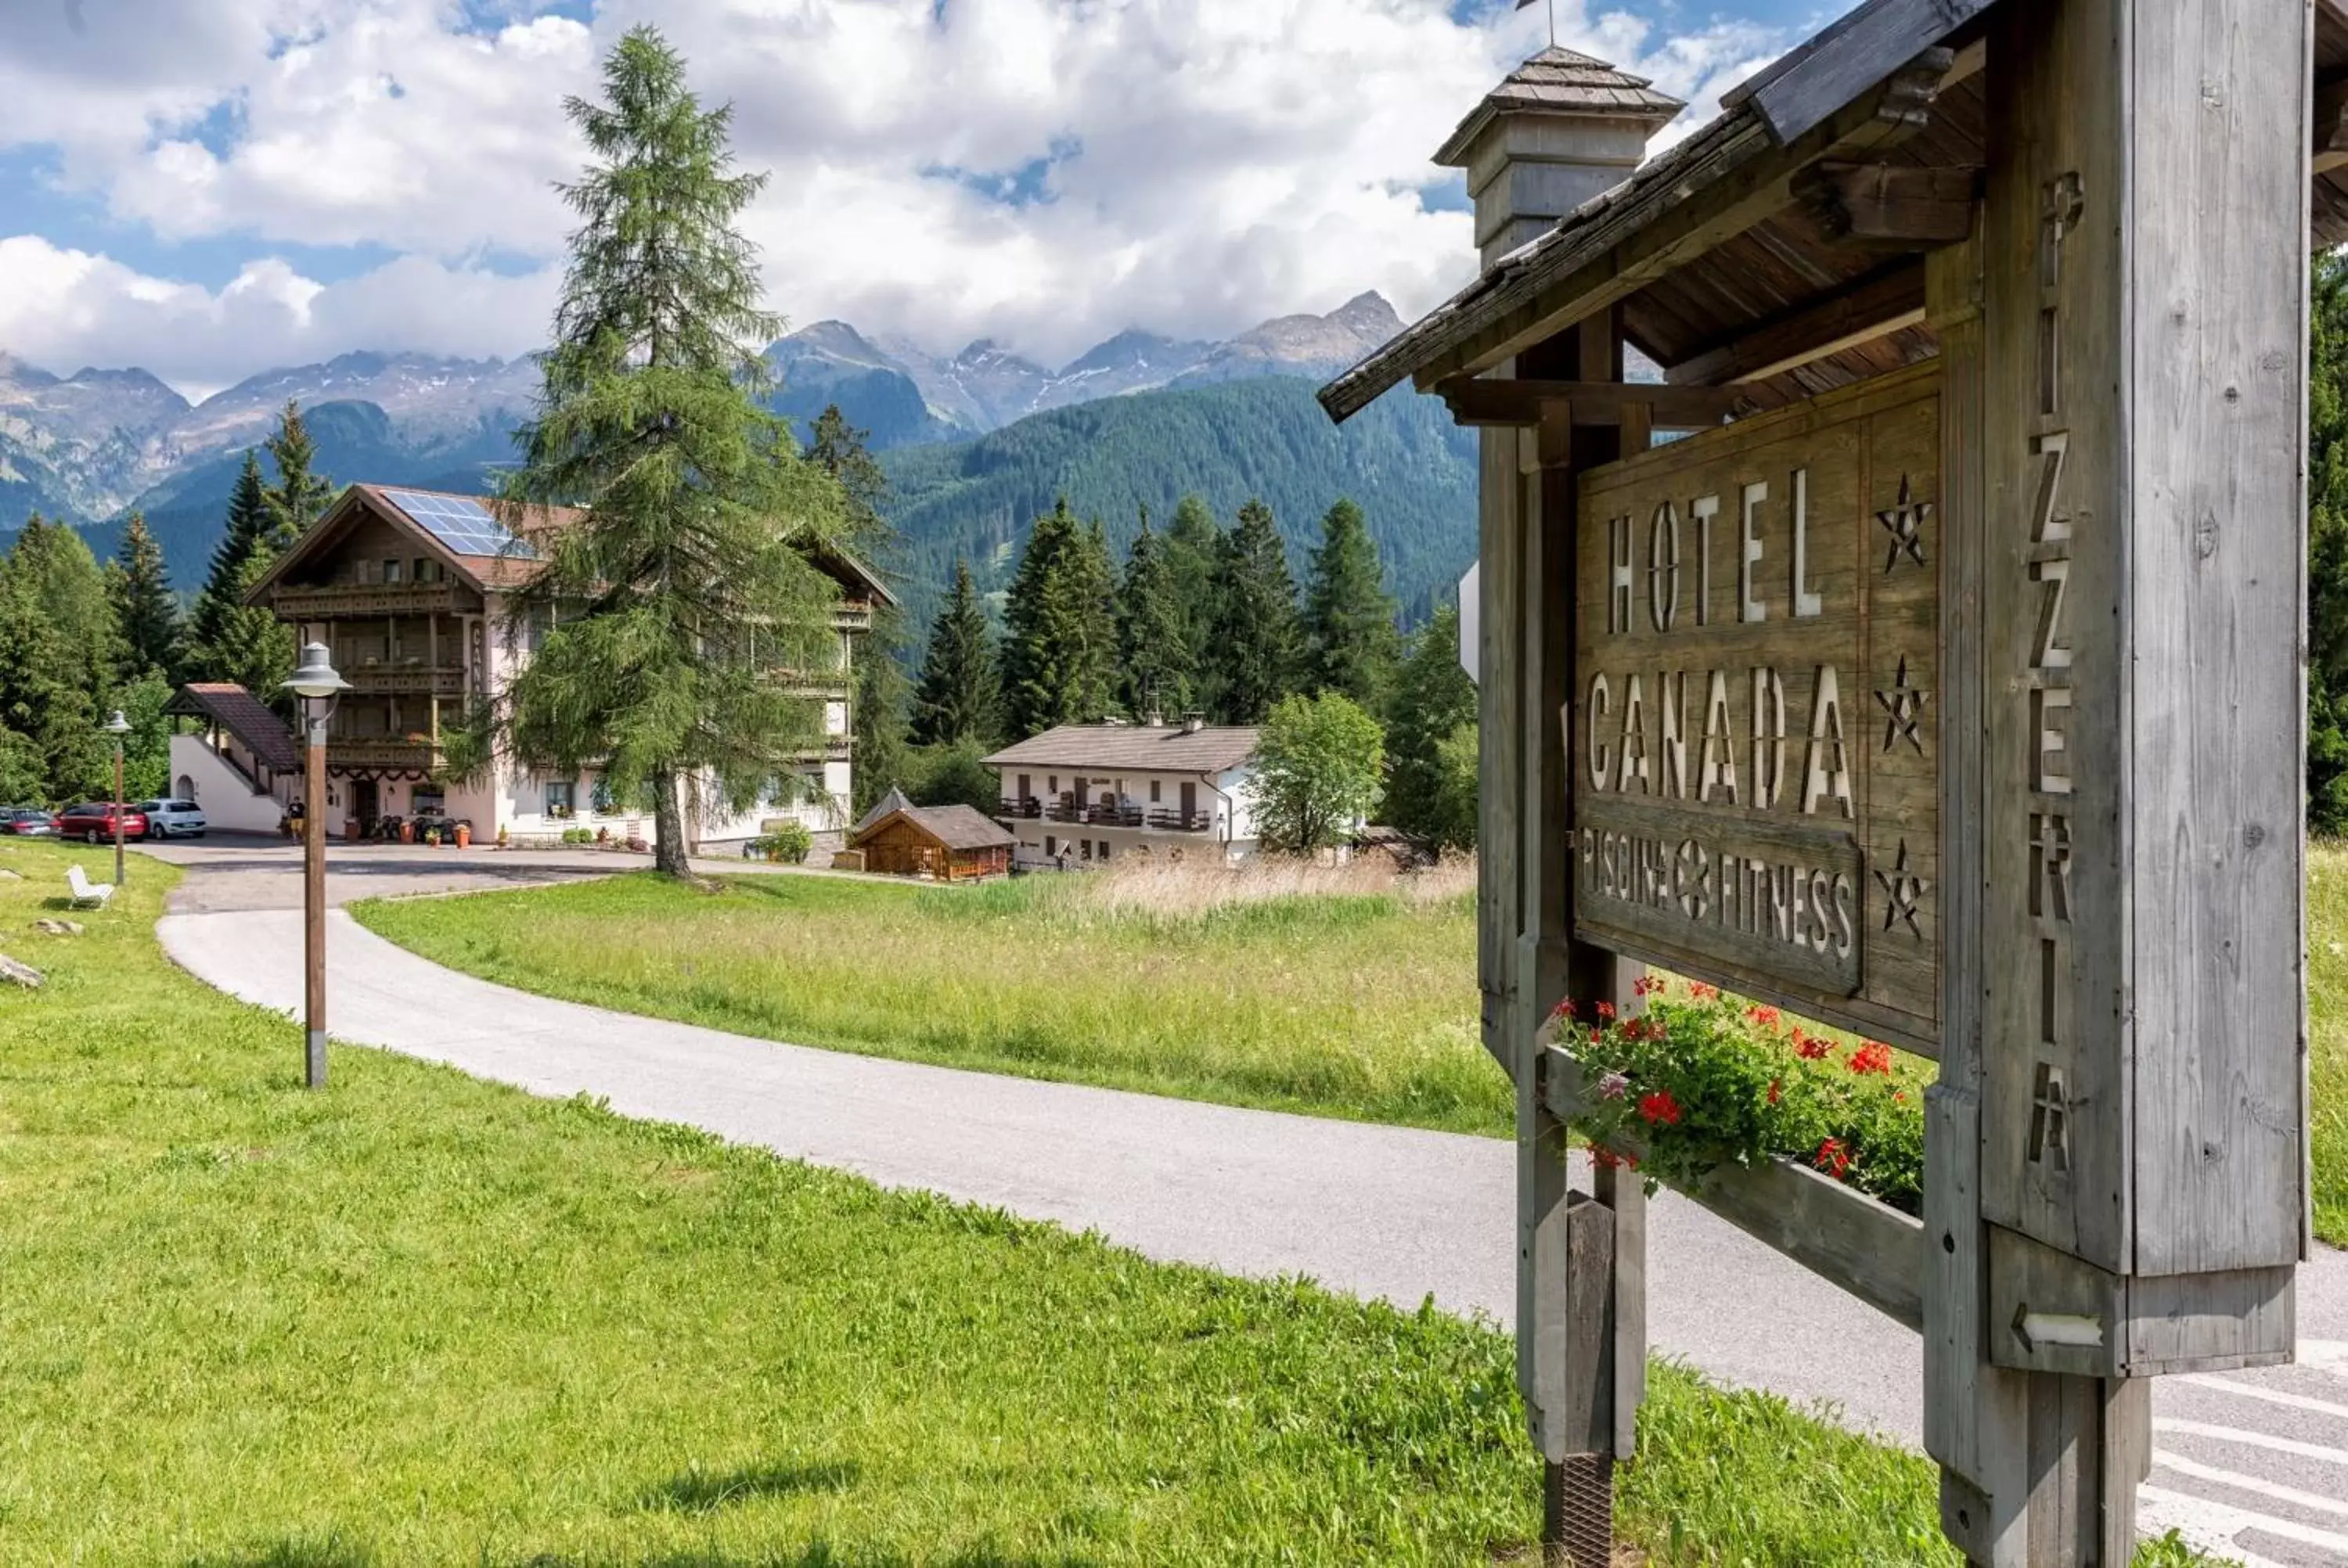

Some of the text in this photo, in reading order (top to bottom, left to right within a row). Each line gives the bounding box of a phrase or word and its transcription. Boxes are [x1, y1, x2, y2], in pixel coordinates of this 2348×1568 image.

[1608, 467, 1821, 635] HOTEL
[1586, 664, 1854, 820] CANADA
[2029, 171, 2084, 1172] PIZZERIA
[1581, 826, 1851, 958] PISCINA FITNESS
